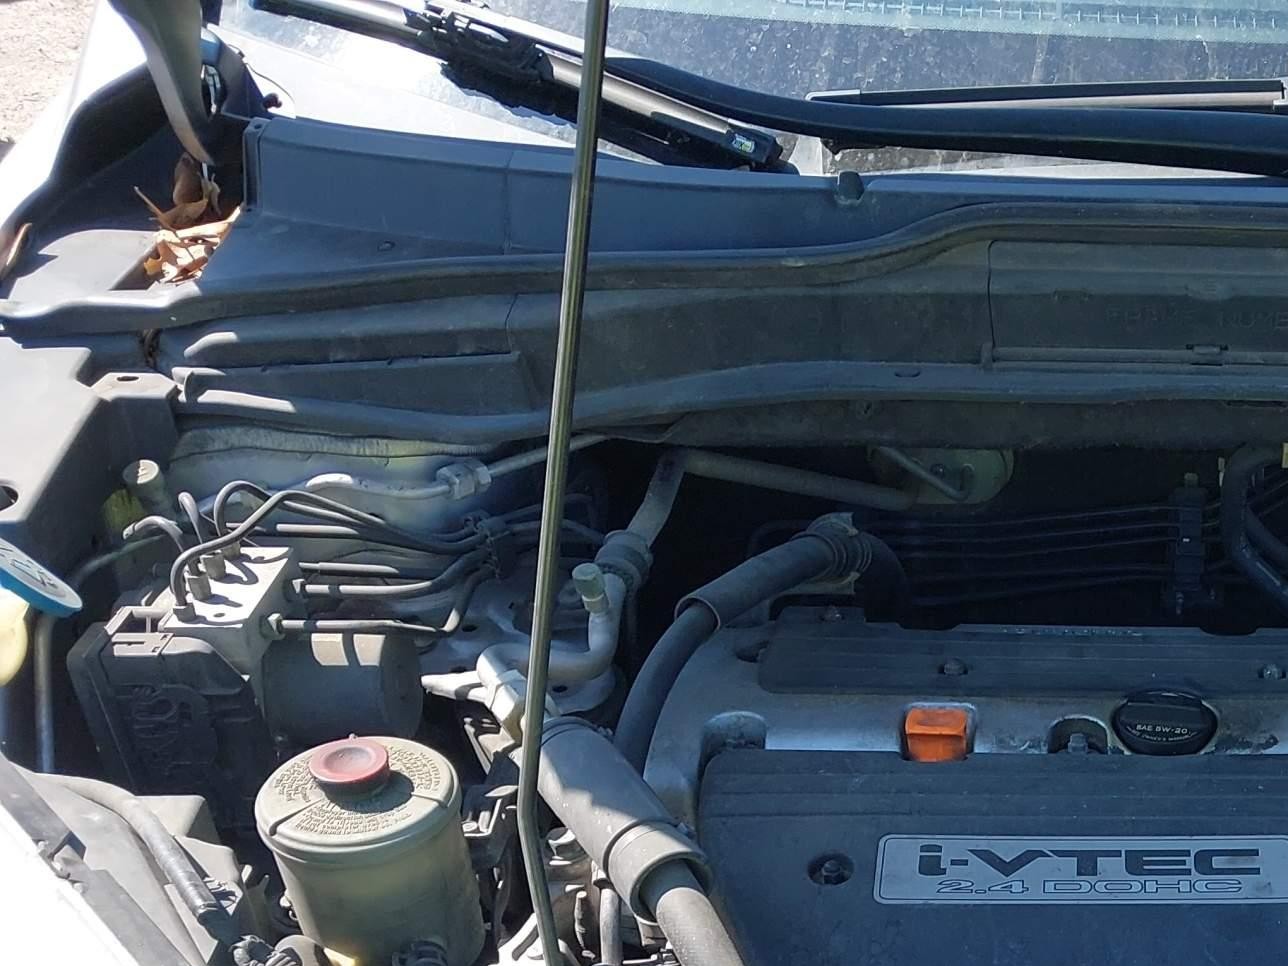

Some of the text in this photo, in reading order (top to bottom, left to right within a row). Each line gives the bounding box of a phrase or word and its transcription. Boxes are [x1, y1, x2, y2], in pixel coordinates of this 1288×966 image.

[917, 843, 1261, 877] i-VTEC
[936, 879, 1243, 895] 2.4 DOHC
